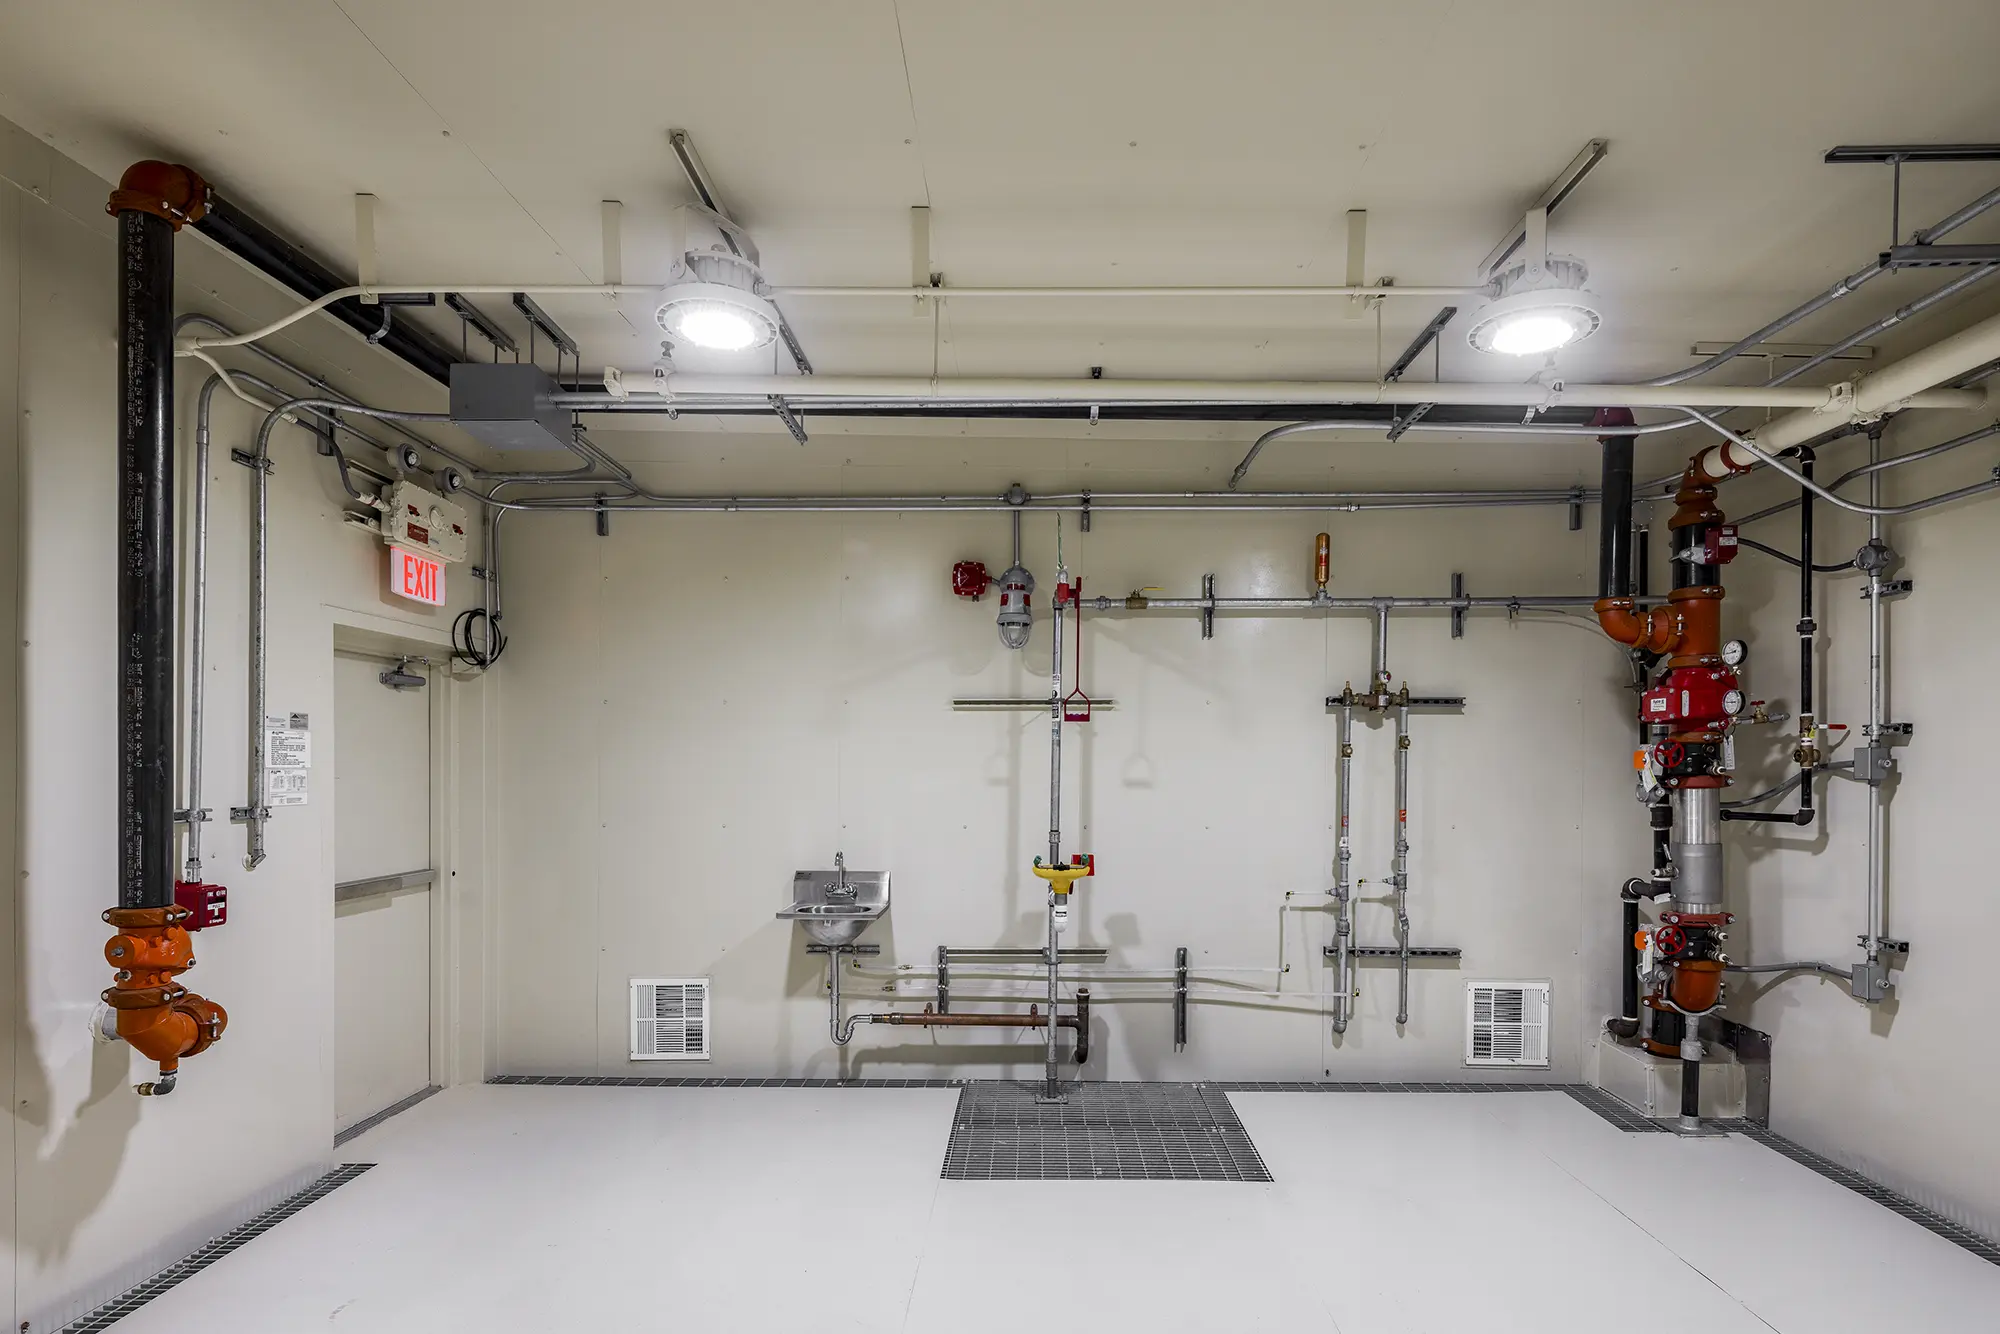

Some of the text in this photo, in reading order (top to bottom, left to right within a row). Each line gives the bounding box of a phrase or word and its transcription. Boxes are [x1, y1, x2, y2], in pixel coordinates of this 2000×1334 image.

[404, 555, 438, 601] EXIT
[126, 818, 134, 838] STEEL
[126, 841, 134, 878] SPRINKLER
[126, 881, 134, 898] PIPE
